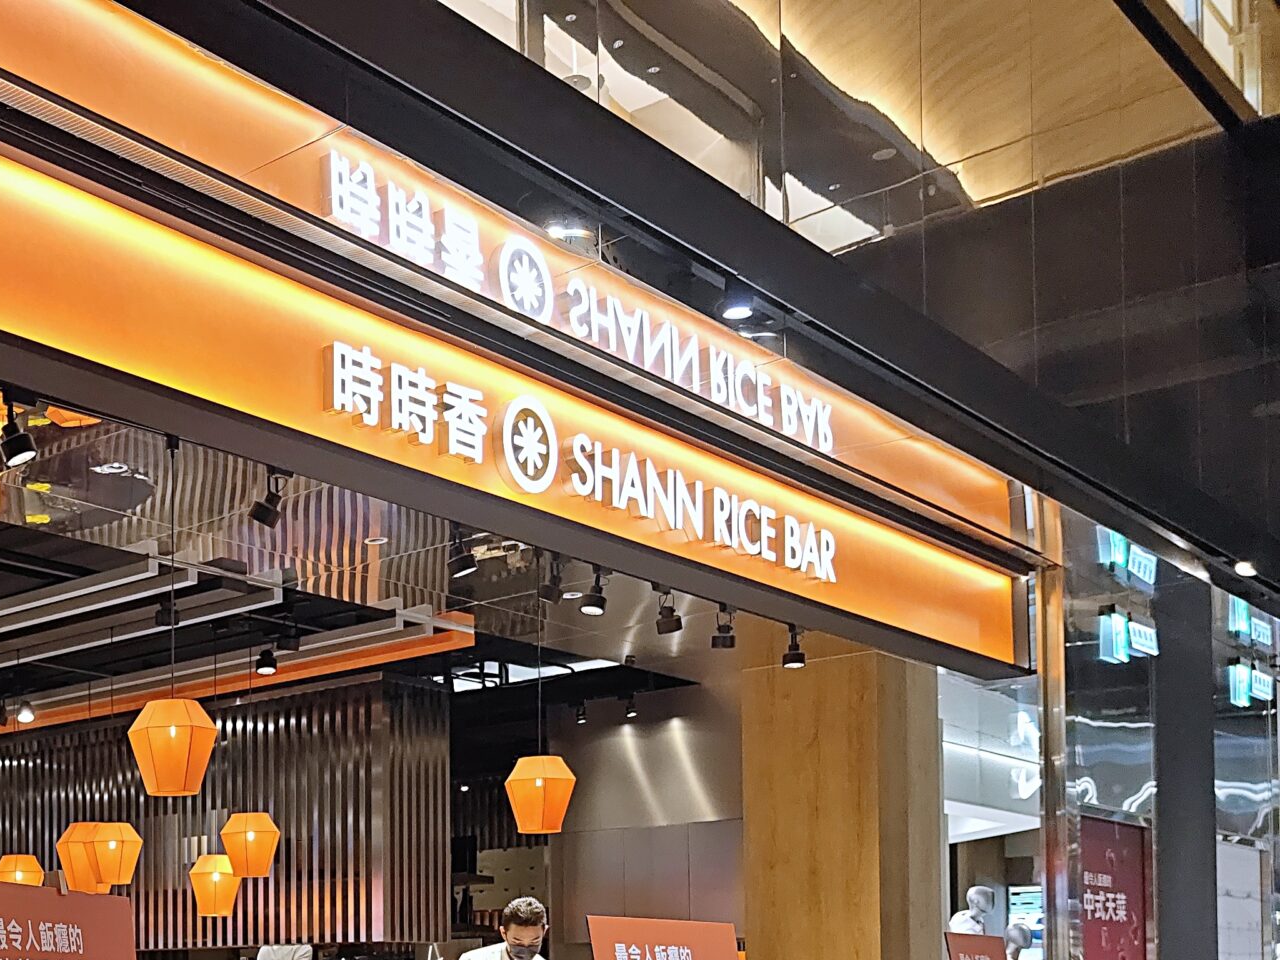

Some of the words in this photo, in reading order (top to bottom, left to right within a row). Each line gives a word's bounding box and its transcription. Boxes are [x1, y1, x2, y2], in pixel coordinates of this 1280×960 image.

[332, 340, 487, 465] 時時香
[571, 433, 703, 541] SHANN
[714, 487, 776, 562] RICE
[785, 516, 836, 584] BAR
[1083, 888, 1127, 922] 中式天菜
